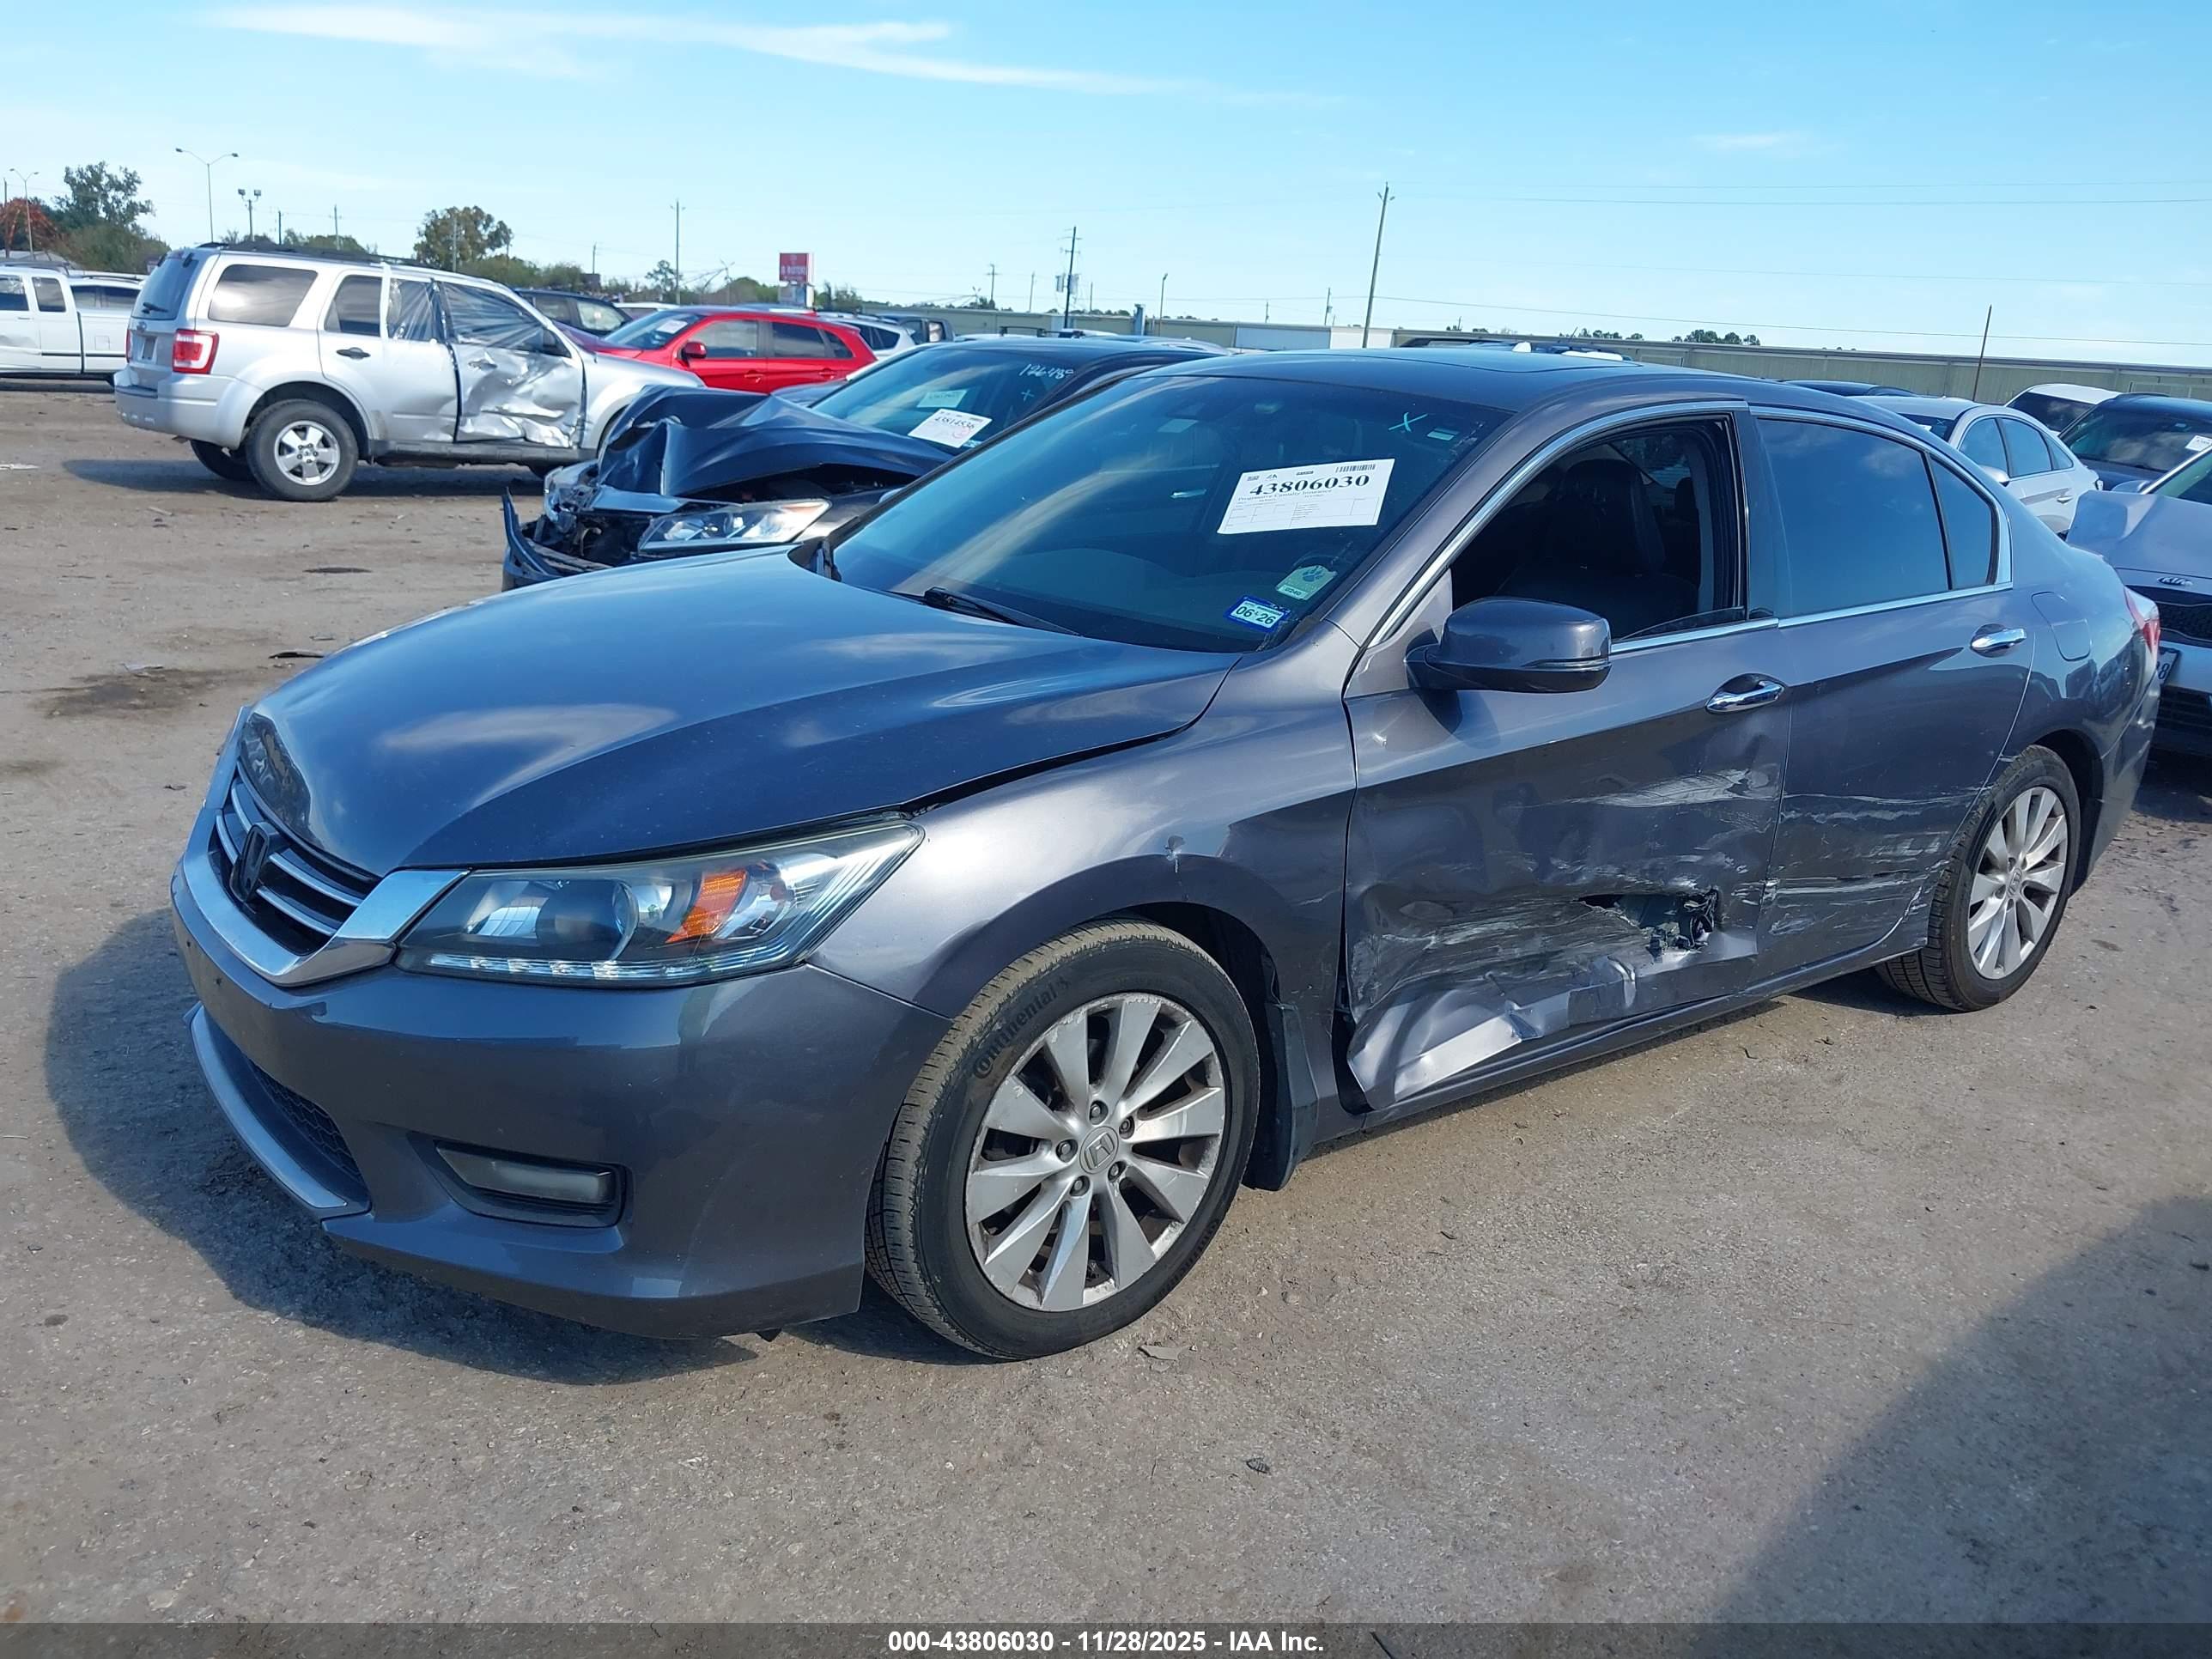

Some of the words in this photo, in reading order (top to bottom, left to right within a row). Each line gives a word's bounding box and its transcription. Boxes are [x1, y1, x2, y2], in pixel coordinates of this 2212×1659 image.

[1249, 474, 1370, 495] 43806030
[1236, 606, 1255, 617] 06
[1257, 613, 1277, 625] 26
[974, 982, 1058, 1079] Continental
